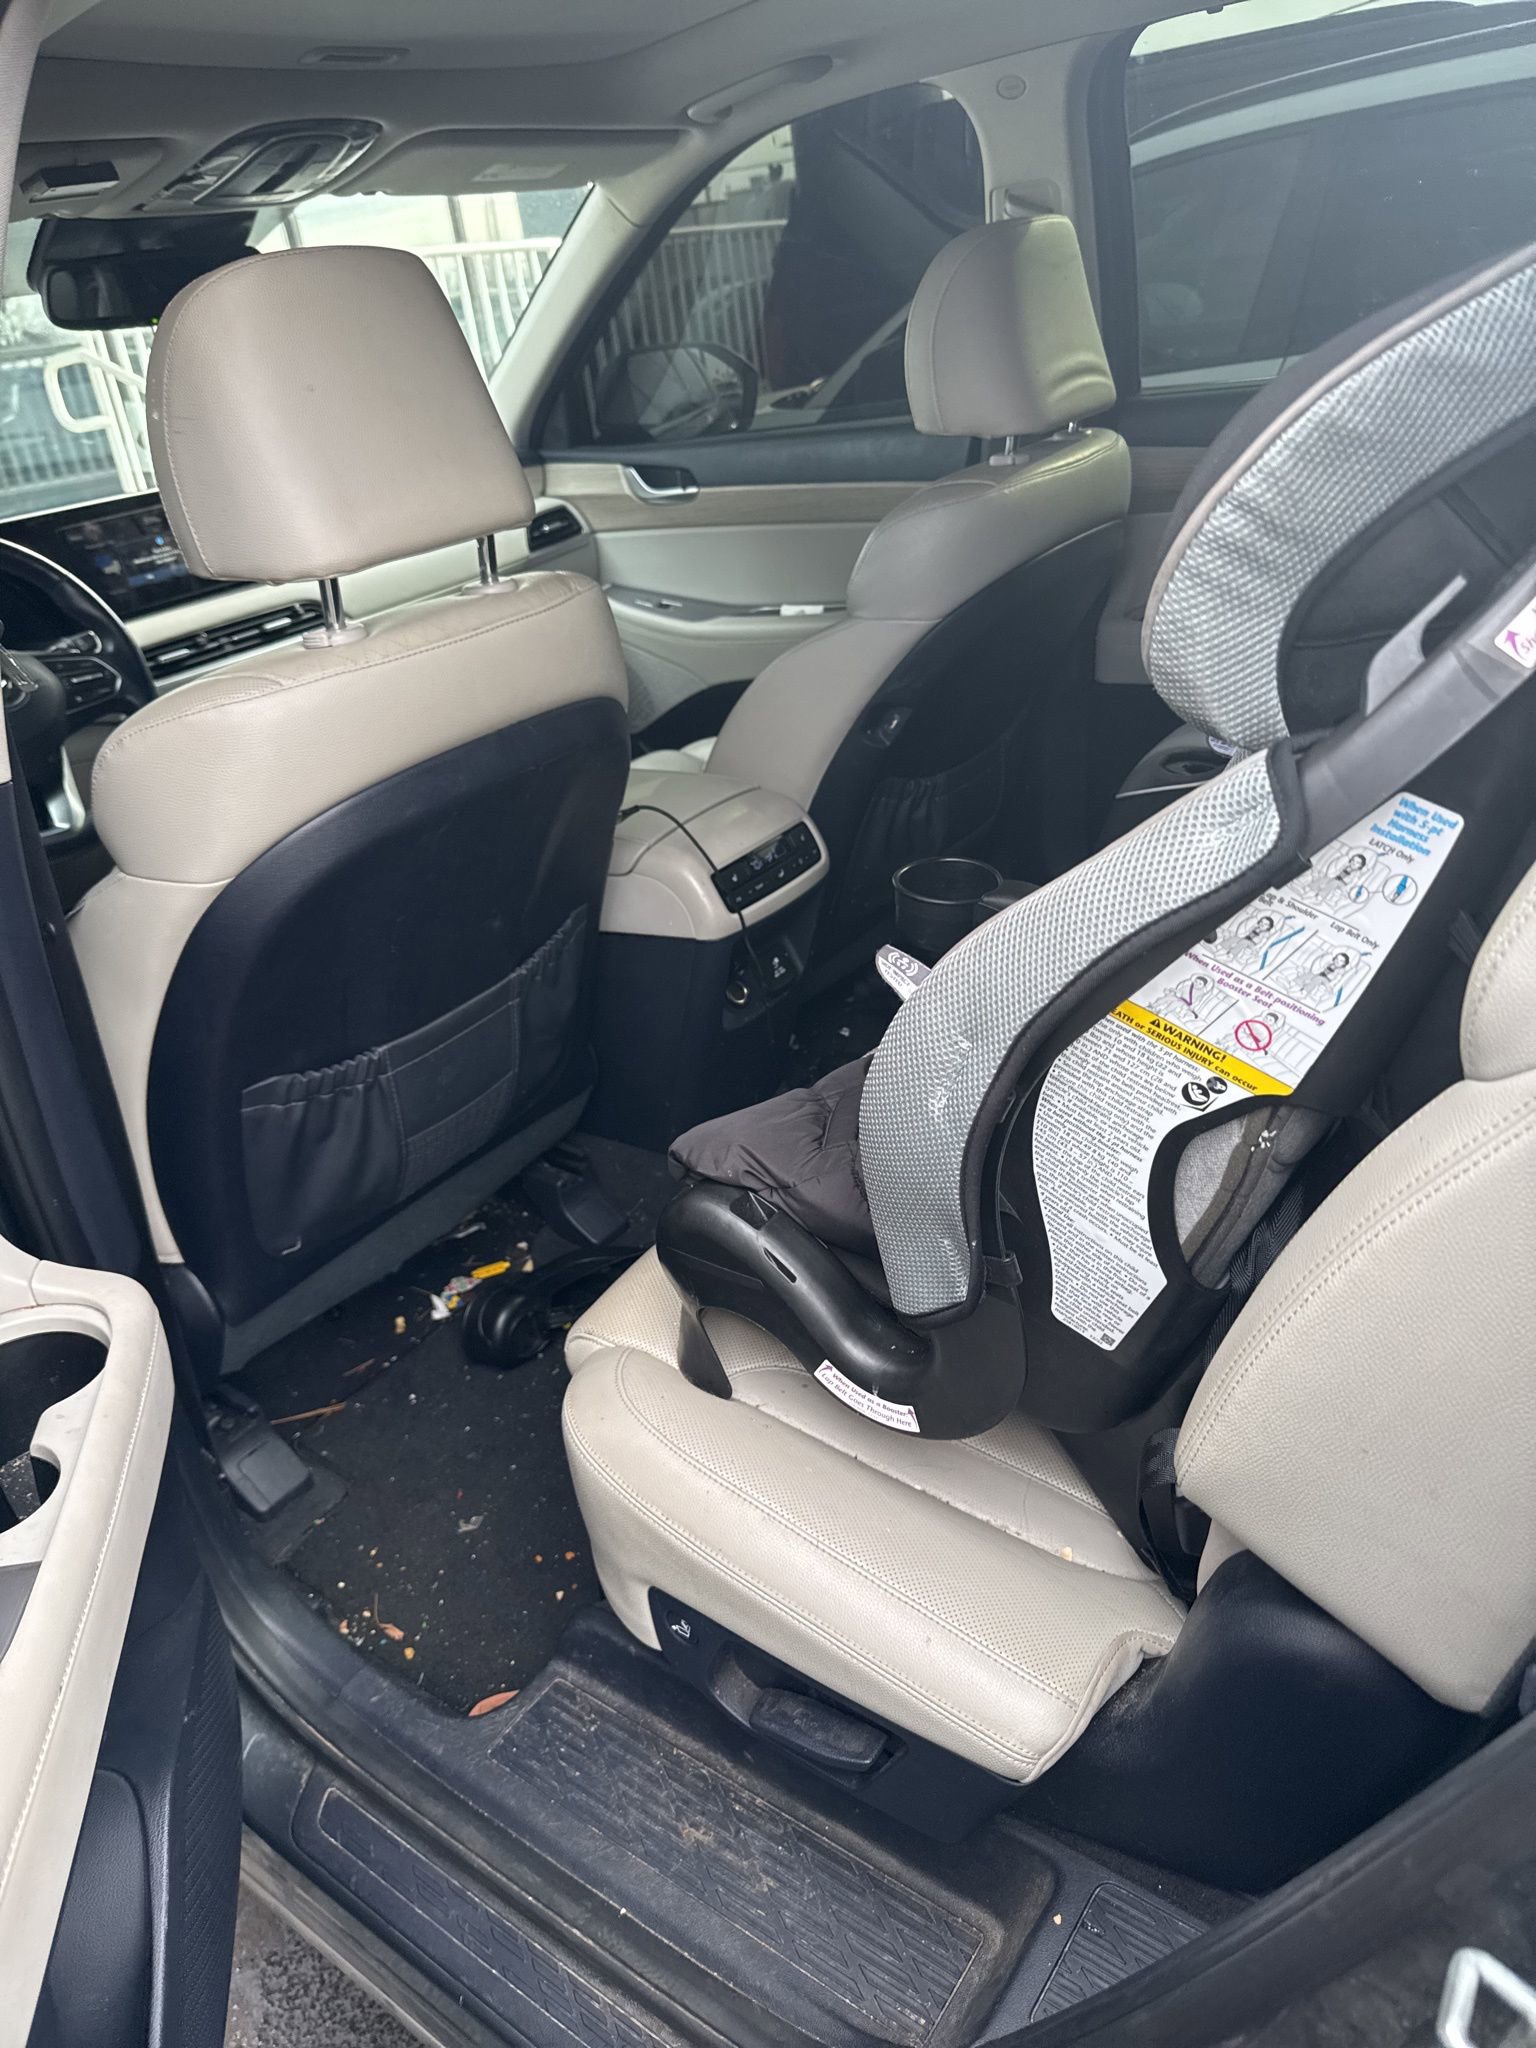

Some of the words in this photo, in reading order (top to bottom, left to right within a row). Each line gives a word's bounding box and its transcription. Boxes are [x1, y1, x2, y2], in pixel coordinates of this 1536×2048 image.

[1388, 818, 1429, 843] Harness
[1394, 807, 1418, 824] with
[1417, 818, 1443, 838] 5-pt
[1398, 796, 1430, 817] When
[1430, 810, 1458, 830] Used
[1369, 837, 1396, 855] LATCH
[1394, 848, 1415, 865] Only
[1370, 822, 1431, 857] Installation
[1276, 896, 1285, 904] &
[1285, 899, 1319, 920] Shoulder
[1329, 920, 1345, 934] Lap
[1345, 927, 1361, 940] Belt
[1359, 935, 1379, 950] Only
[1182, 949, 1210, 967] When
[1210, 962, 1234, 979] Used
[1233, 976, 1243, 984] as
[1252, 984, 1325, 1026] Belt-positioning
[1216, 976, 1251, 998] Booster
[1251, 993, 1273, 1009] Seat
[1088, 1030, 1102, 1042] lbs)
[1101, 1037, 1115, 1048] and
[1114, 1045, 1137, 1061] whose
[1135, 1057, 1158, 1074] height
[1107, 1025, 1124, 1038] only
[1123, 1033, 1139, 1046] with
[1138, 1042, 1166, 1061] children
[1164, 1058, 1181, 1070] who
[1179, 1067, 1202, 1083] weigh
[1110, 1007, 1134, 1024] EATH
[1134, 1021, 1145, 1030] or
[1145, 1026, 1182, 1050] SERIOUS
[1182, 1046, 1213, 1068] INJURY
[1213, 1064, 1232, 1078] can
[1231, 1074, 1257, 1091] occur
[1112, 1036, 1122, 1044] 10
[1123, 1042, 1136, 1052] and
[1135, 1049, 1146, 1058] 18
[1144, 1054, 1155, 1065] kg
[1153, 1060, 1168, 1072] (22
[1166, 1067, 1181, 1078] and
[1116, 1022, 1132, 1034] used
[1131, 1031, 1147, 1043] with
[1145, 1039, 1158, 1049] the
[1161, 1022, 1227, 1062] WARNING!
[1053, 1062, 1081, 1082] provided
[1080, 1078, 1096, 1090] with
[1095, 1086, 1108, 1097] this
[1107, 1094, 1124, 1107] child
[1060, 1051, 1072, 1061] this
[1071, 1057, 1087, 1070] child
[1086, 1066, 1111, 1084] restraint
[1110, 1081, 1133, 1097] around
[1131, 1095, 1147, 1107] your
[1061, 1059, 1082, 1074] Secure
[1081, 1071, 1093, 1081] the
[1091, 1077, 1105, 1089] top
[1103, 1084, 1137, 1108] anchorage
[1135, 1103, 1153, 1118] strap
[1068, 1049, 1091, 1066] Snugly
[1089, 1061, 1110, 1077] adjust
[1109, 1072, 1121, 1082] the
[1120, 1079, 1136, 1091] belts
[1134, 1088, 1163, 1108] provided
[1162, 1104, 1177, 1115] with
[1078, 1047, 1092, 1058] top
[1090, 1054, 1099, 1062] of
[1098, 1058, 1111, 1069] the
[1109, 1065, 1127, 1078] child
[1125, 1075, 1153, 1094] restraint
[1080, 1041, 1093, 1052] in.)
[1092, 1047, 1109, 1060] AND
[1108, 1057, 1130, 1072] whose
[1129, 1070, 1143, 1080] ears
[1142, 1078, 1154, 1087] are
[1154, 1083, 1175, 1098] below
[1103, 1046, 1113, 1055] 71
[1112, 1051, 1126, 1063] and
[1125, 1059, 1140, 1070] 127
[1138, 1068, 1150, 1077] cm
[1149, 1073, 1163, 1085] (28
[1162, 1080, 1176, 1091] and
[1056, 1070, 1077, 1086] Secure
[1076, 1082, 1089, 1093] this
[1088, 1089, 1105, 1103] child
[1103, 1099, 1130, 1118] restraint
[1129, 1114, 1145, 1127] with
[1144, 1123, 1156, 1134] the
[1041, 1198, 1065, 1216] General
[820, 1372, 834, 1386] Lap
[834, 1383, 848, 1396] Belt
[847, 1393, 865, 1407] Goes
[865, 1404, 895, 1423] Through
[895, 1417, 912, 1427] Here
[831, 1373, 850, 1389] When
[850, 1386, 867, 1399] Used
